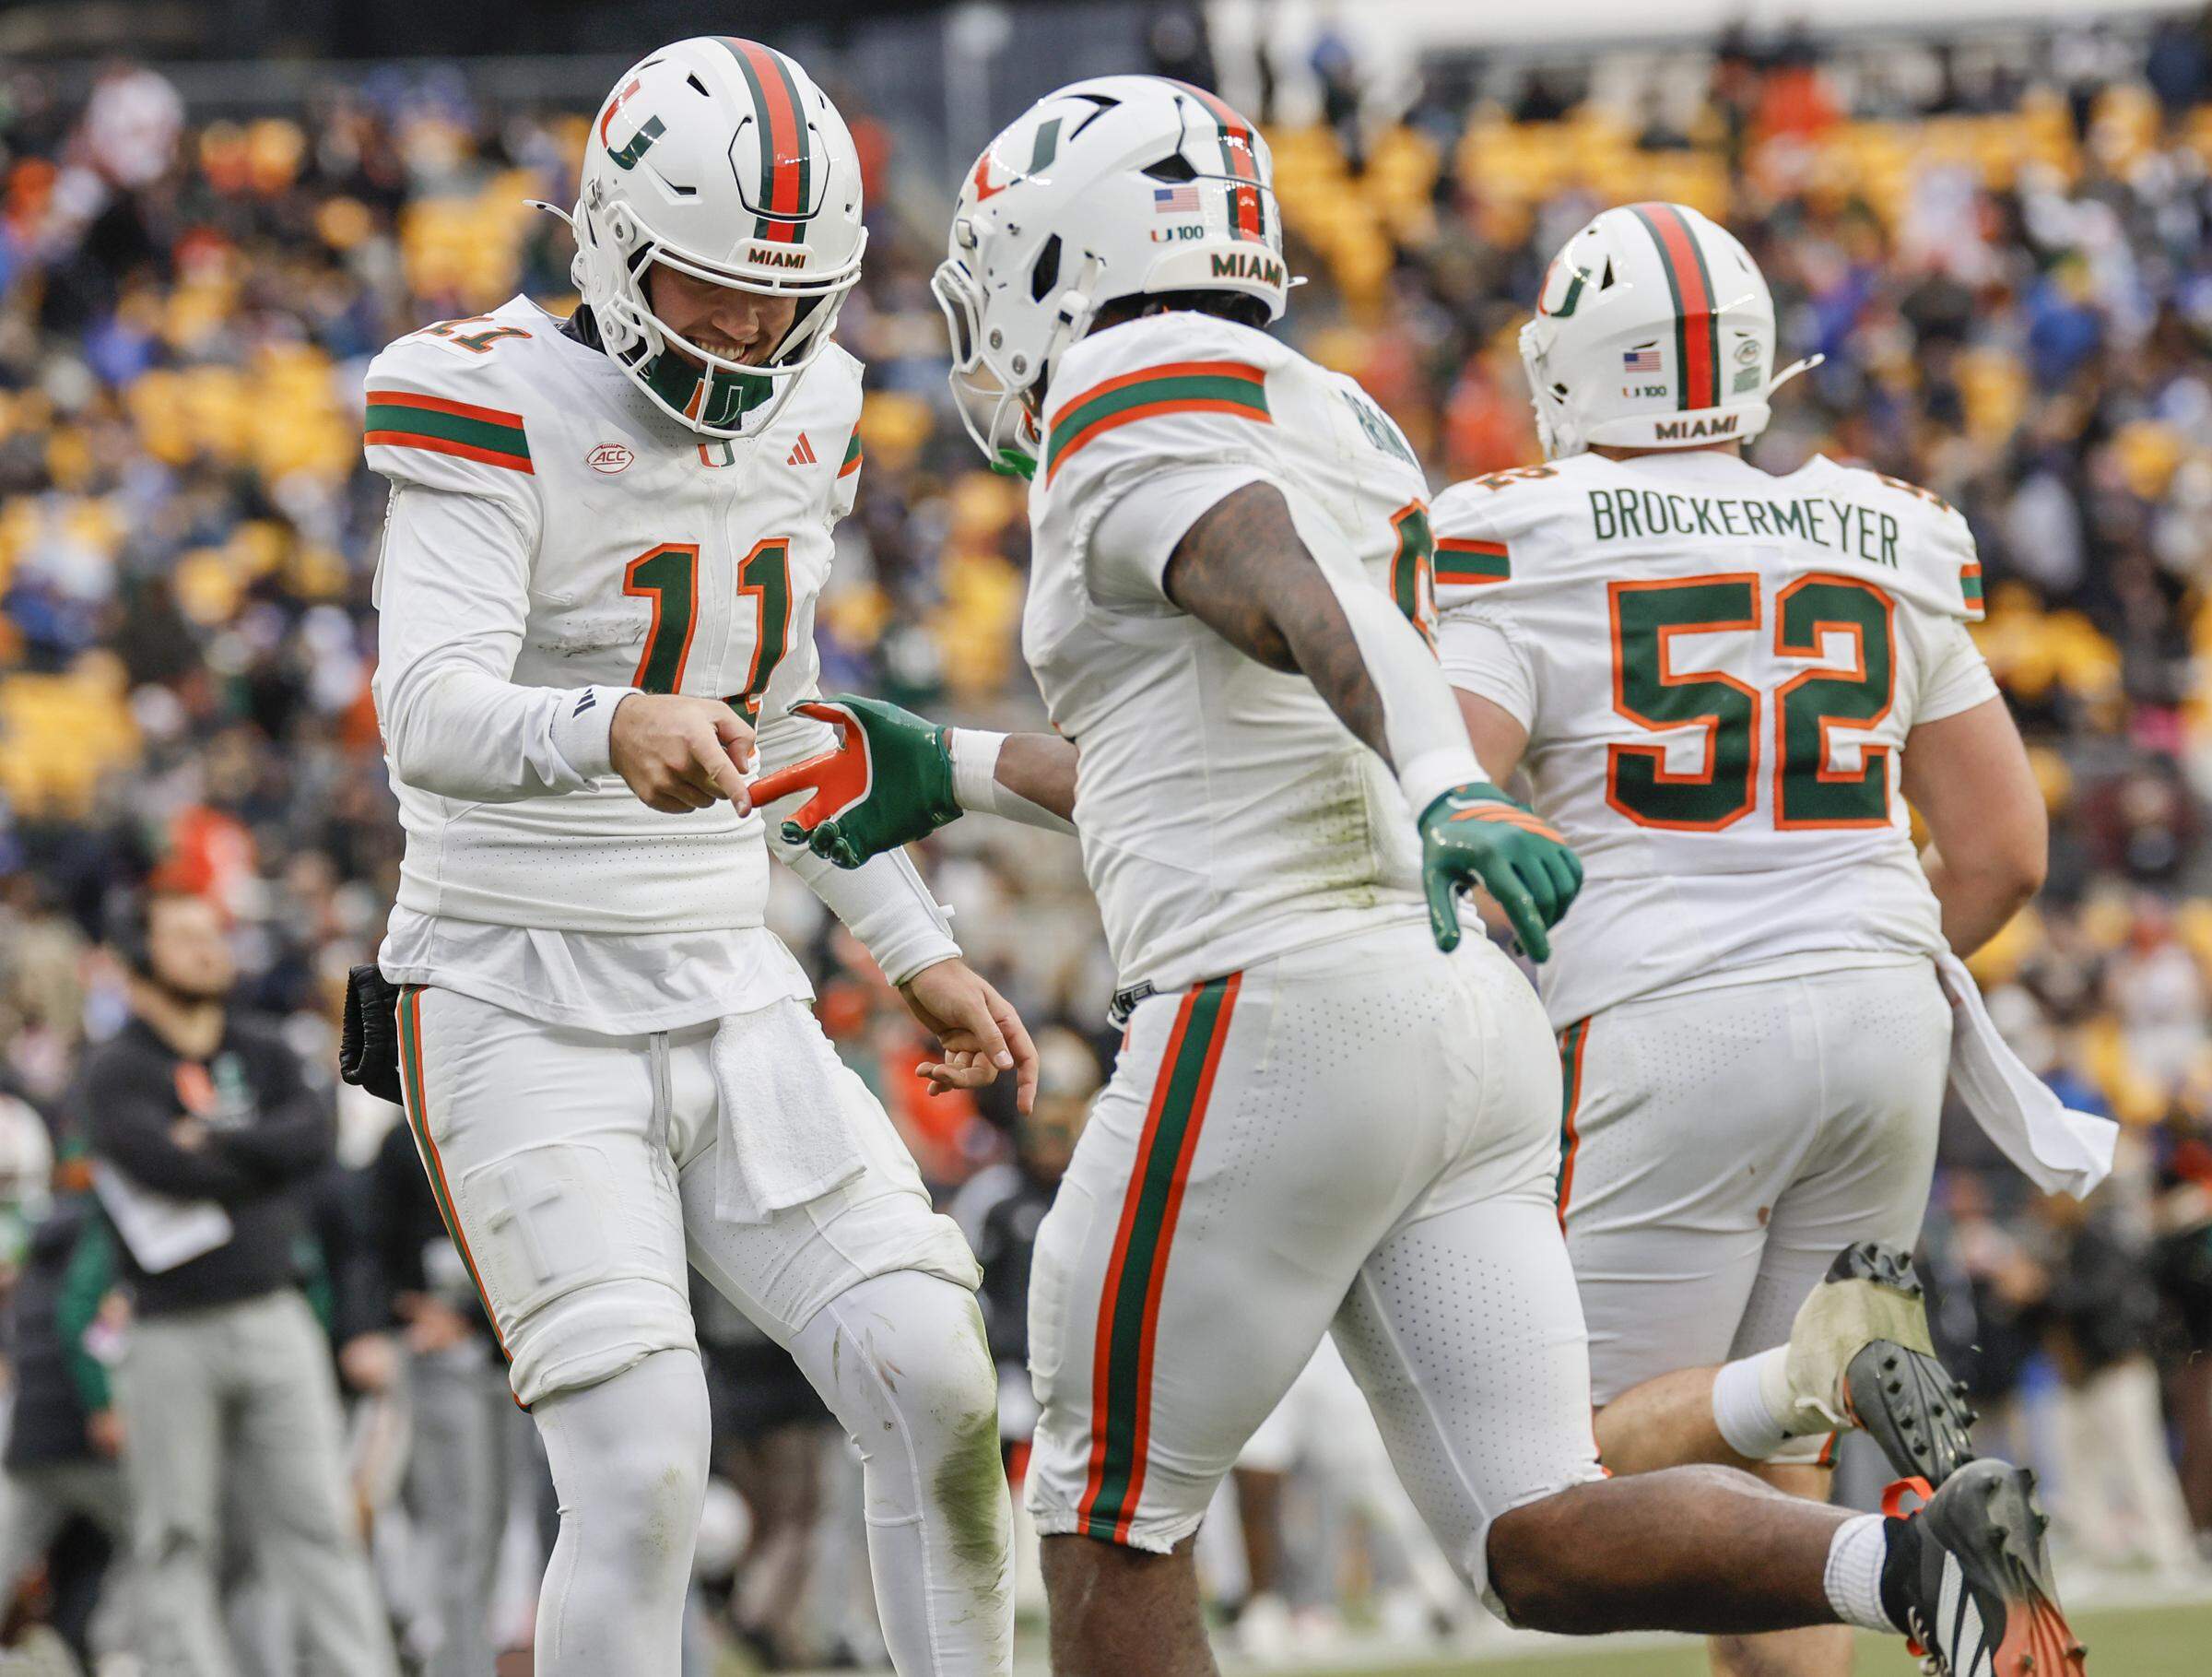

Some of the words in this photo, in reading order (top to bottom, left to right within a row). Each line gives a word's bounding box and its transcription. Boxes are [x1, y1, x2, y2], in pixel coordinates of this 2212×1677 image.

[1177, 226, 1204, 240] 100
[748, 247, 806, 269] MIAMI
[1211, 254, 1283, 289] MIAMI
[1643, 385, 1667, 398] 100
[1654, 415, 1739, 440] MIAMI
[594, 450, 627, 463] ACC
[1589, 489, 1899, 569] BROCKERMEYER
[622, 537, 793, 728] 11
[1606, 572, 1896, 833] 52
